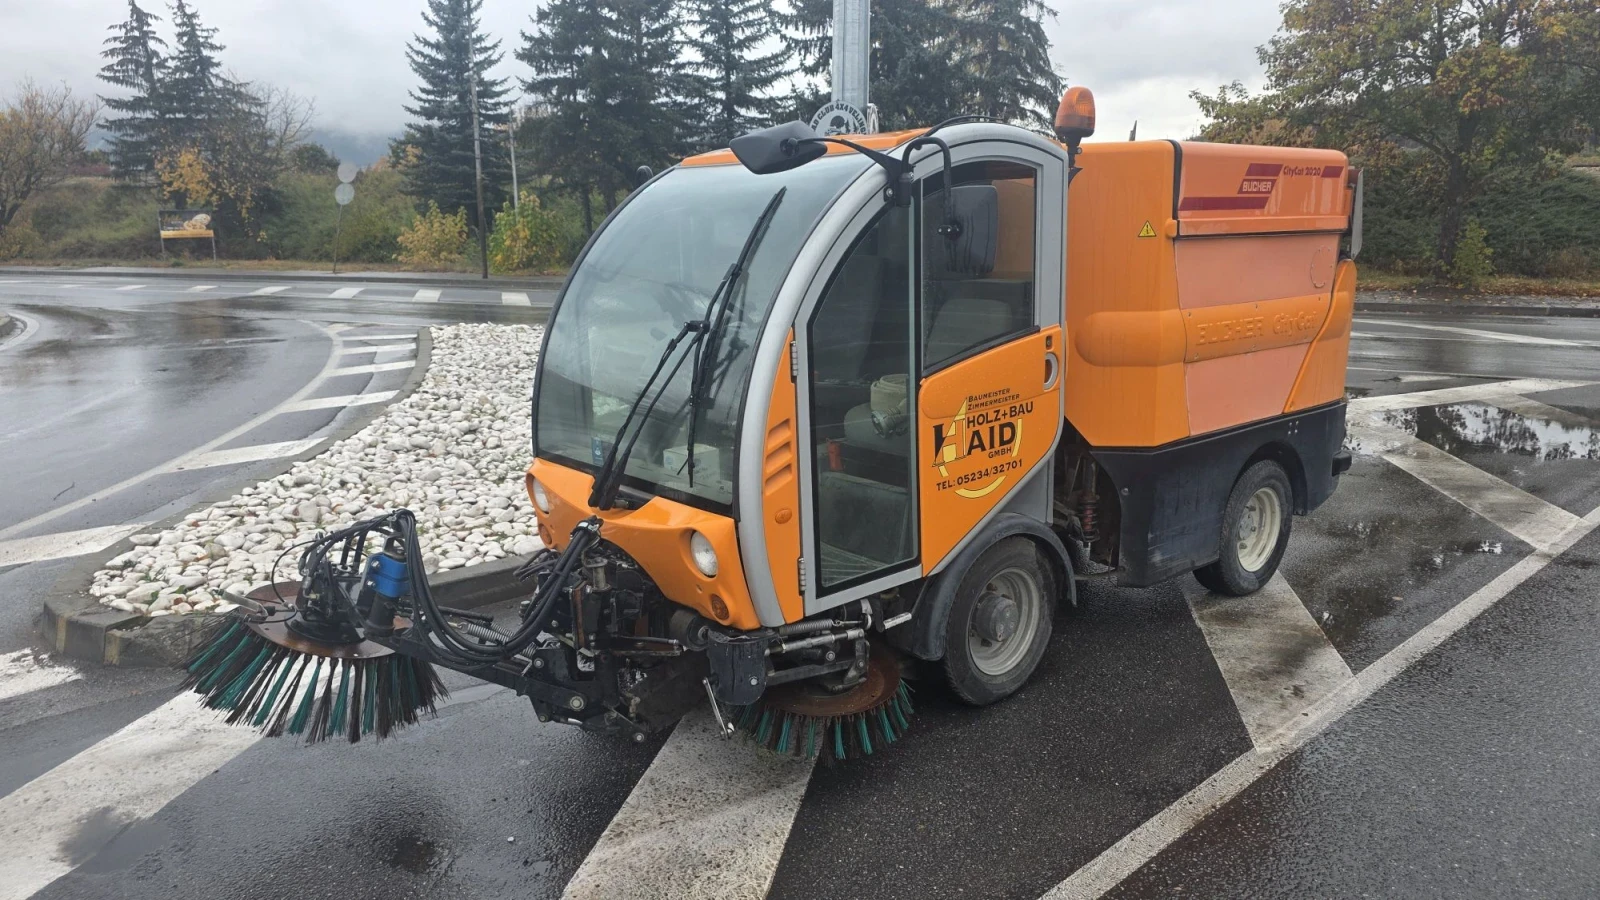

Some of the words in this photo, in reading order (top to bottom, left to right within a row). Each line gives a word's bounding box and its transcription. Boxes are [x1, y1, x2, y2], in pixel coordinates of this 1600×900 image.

[817, 104, 835, 120] CLUB
[1305, 166, 1321, 176] 2020
[1242, 181, 1272, 192] BUCHER
[967, 393, 1020, 411] ZIMMERMEISTER
[968, 388, 1011, 402] BAUMEISTER
[966, 401, 1034, 429] HOLZ+BAU
[988, 446, 1012, 459] GMBH
